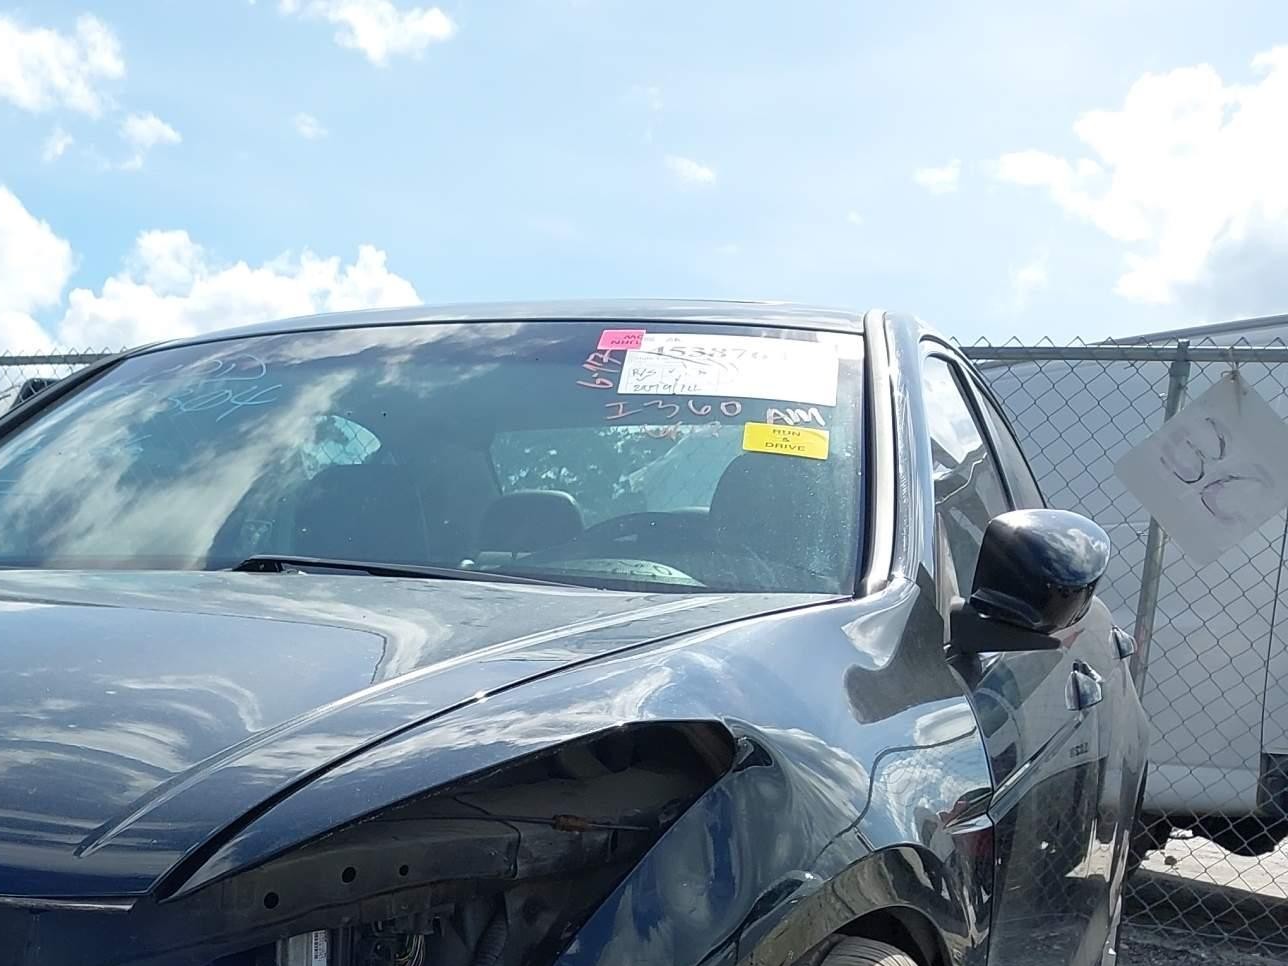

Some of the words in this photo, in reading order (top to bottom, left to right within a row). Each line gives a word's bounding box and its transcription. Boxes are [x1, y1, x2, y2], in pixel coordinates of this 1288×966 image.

[766, 407, 826, 427] AM
[772, 428, 801, 437] RUN
[765, 441, 807, 452] DRIVE
